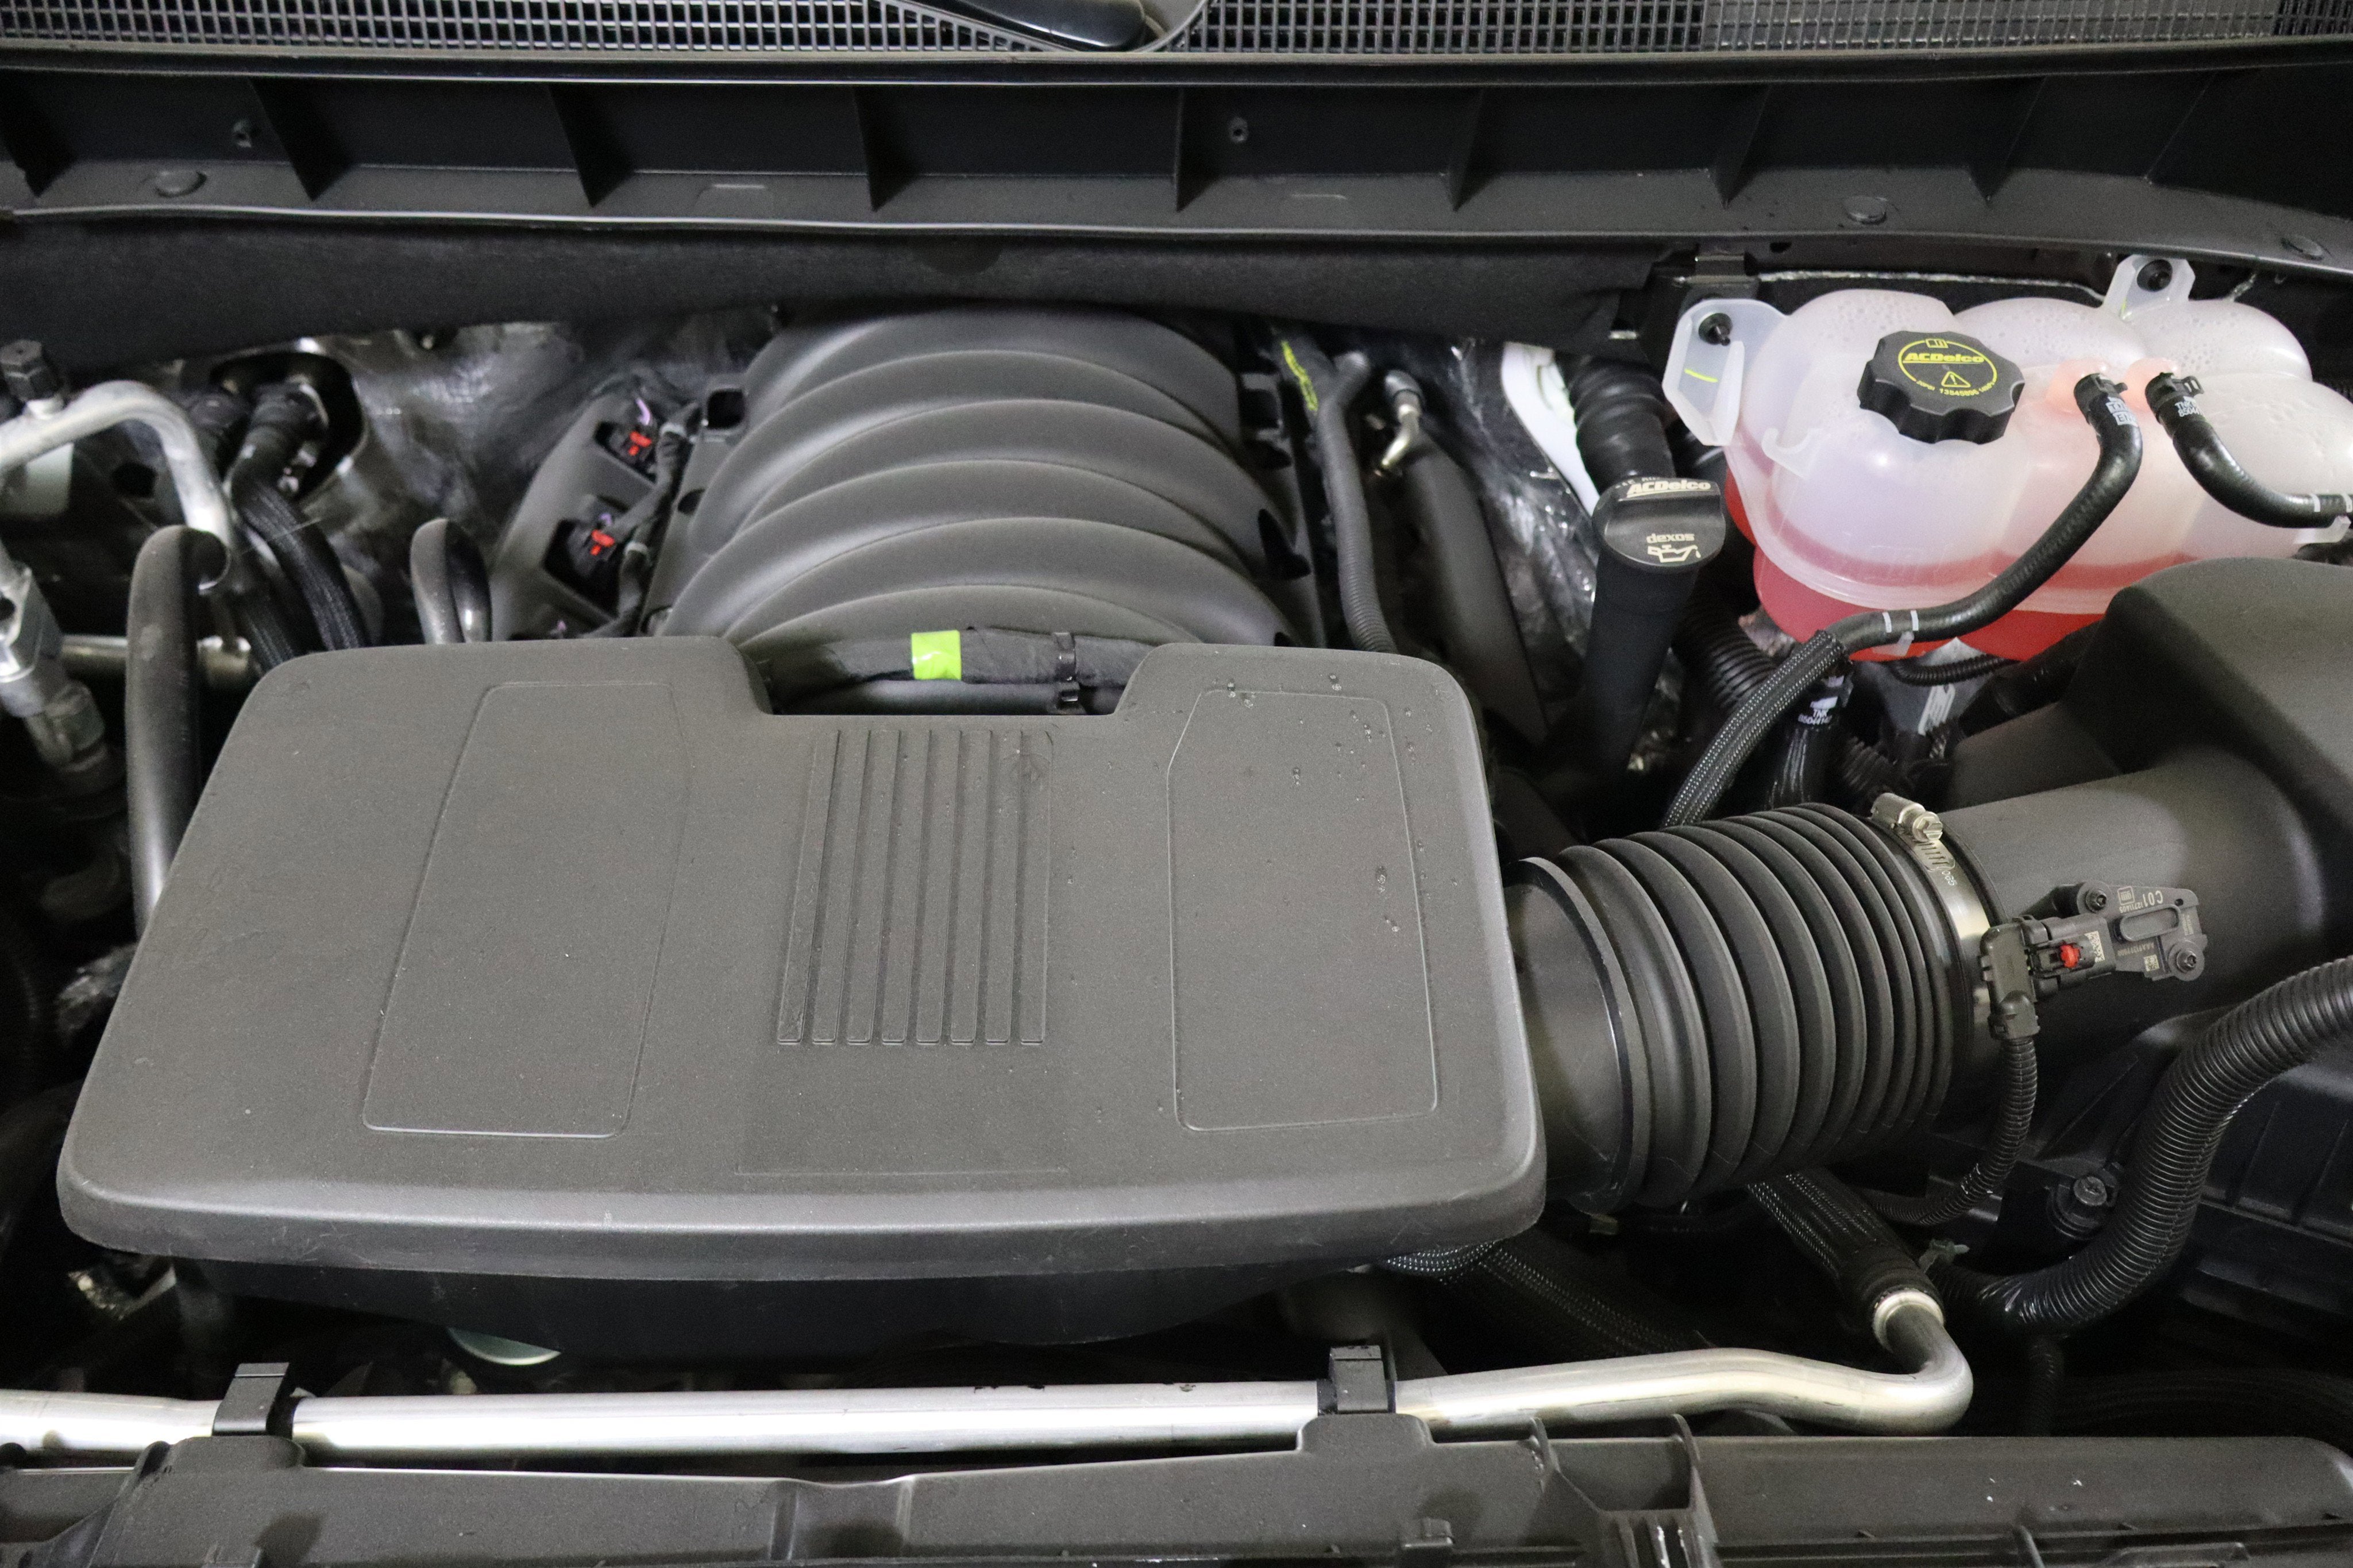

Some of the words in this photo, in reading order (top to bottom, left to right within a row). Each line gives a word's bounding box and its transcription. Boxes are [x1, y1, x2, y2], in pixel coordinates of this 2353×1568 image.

[1904, 353, 1984, 362] ACDelco
[1627, 480, 1711, 496] ACDelco
[1646, 533, 1695, 543] dexos
[2142, 890, 2163, 907] C01
